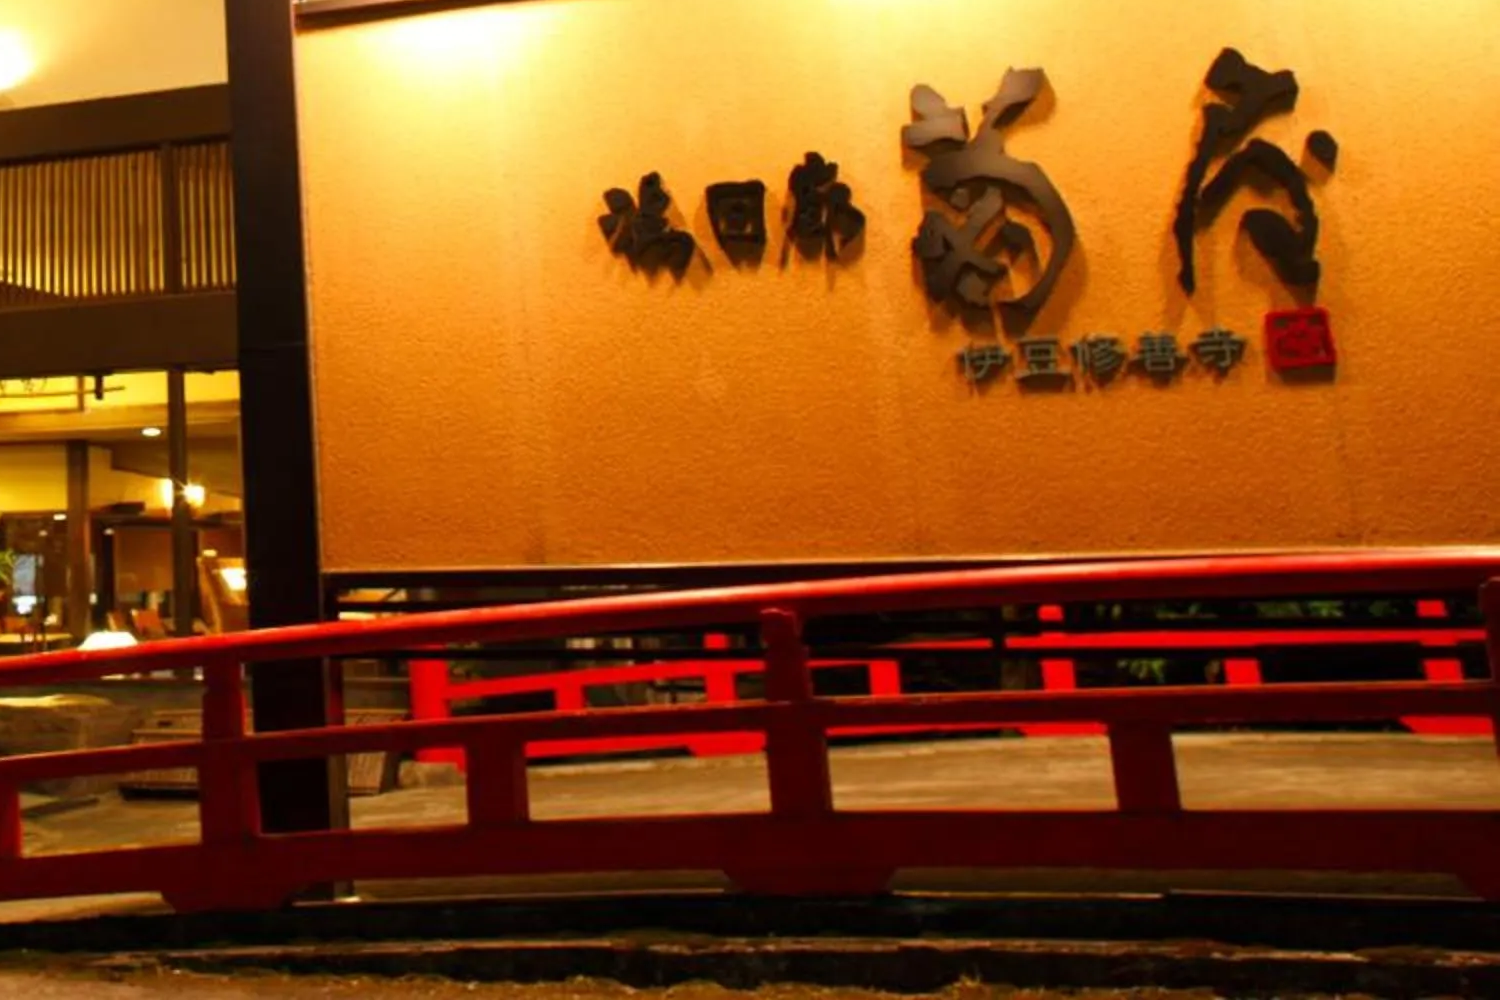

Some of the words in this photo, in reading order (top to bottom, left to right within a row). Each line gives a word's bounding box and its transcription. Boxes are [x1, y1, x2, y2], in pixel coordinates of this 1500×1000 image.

[957, 326, 1246, 382] 伊豆修善寺
